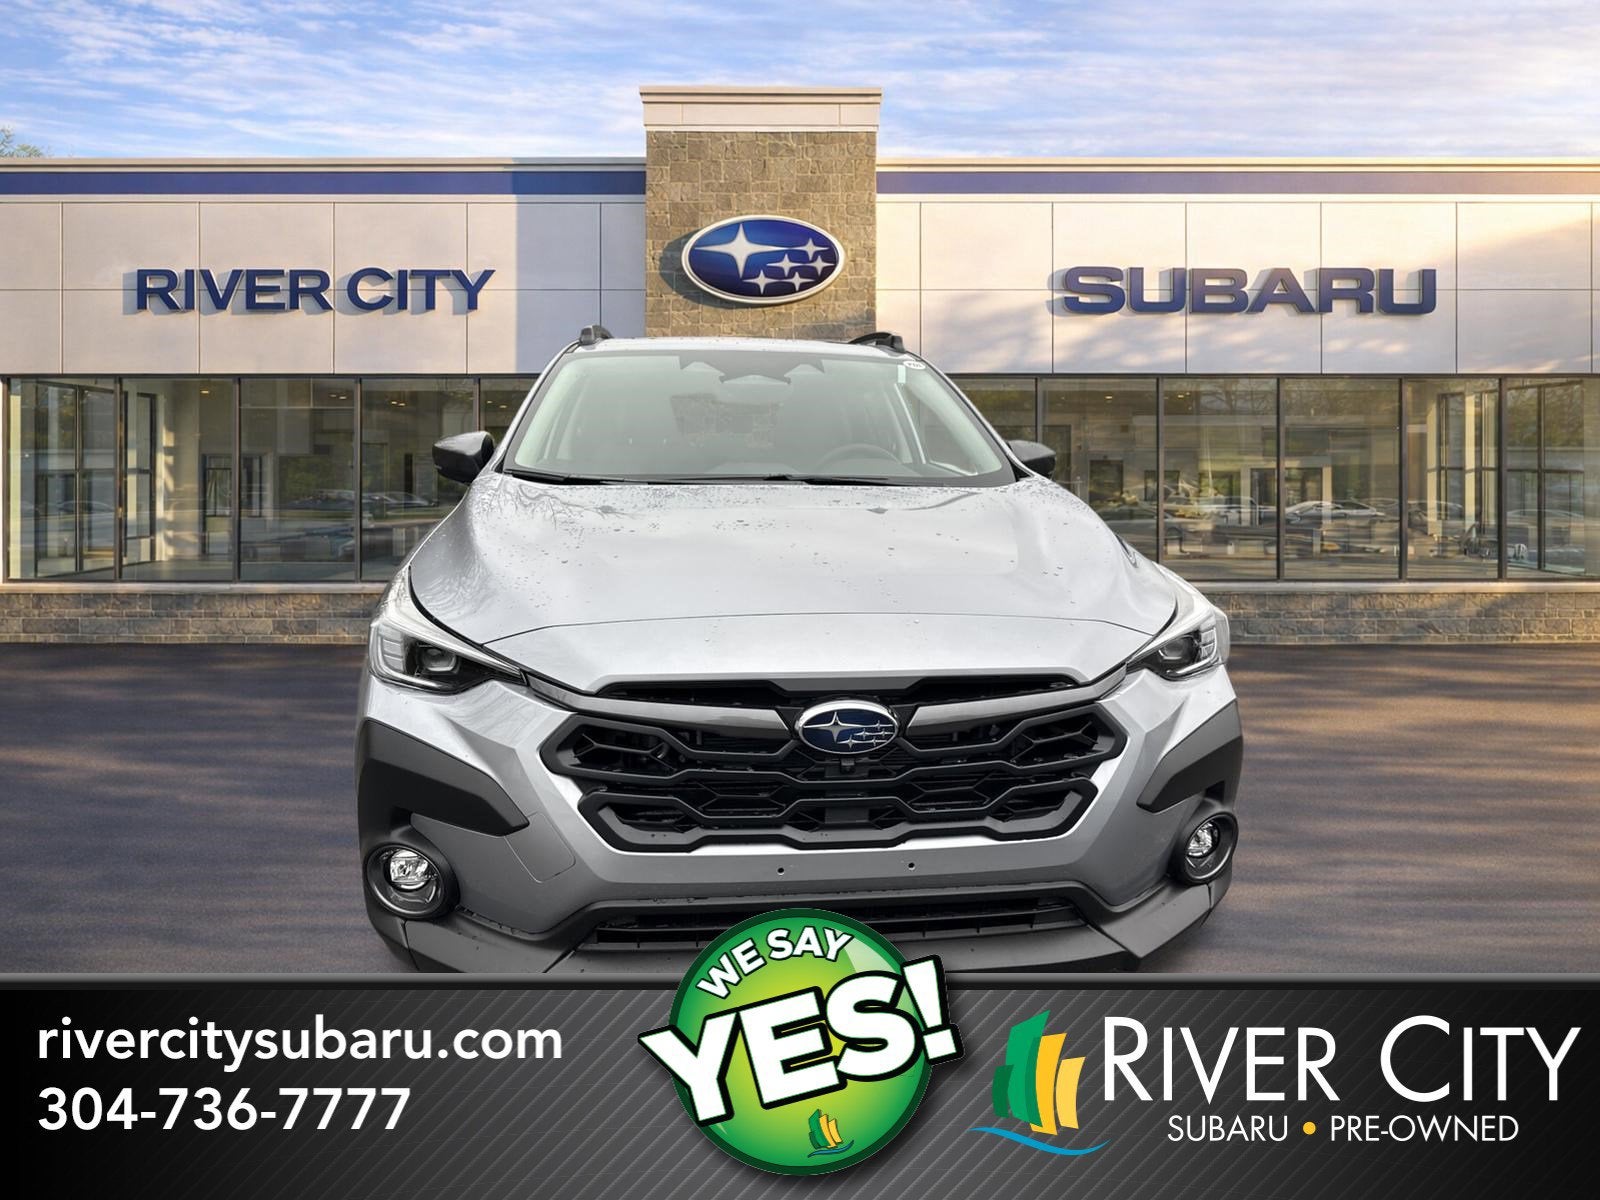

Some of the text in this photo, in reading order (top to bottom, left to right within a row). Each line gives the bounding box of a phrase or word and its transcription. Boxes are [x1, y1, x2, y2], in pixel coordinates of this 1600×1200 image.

[136, 266, 497, 314] RIVER CITY
[1062, 266, 1438, 315] SUBARU
